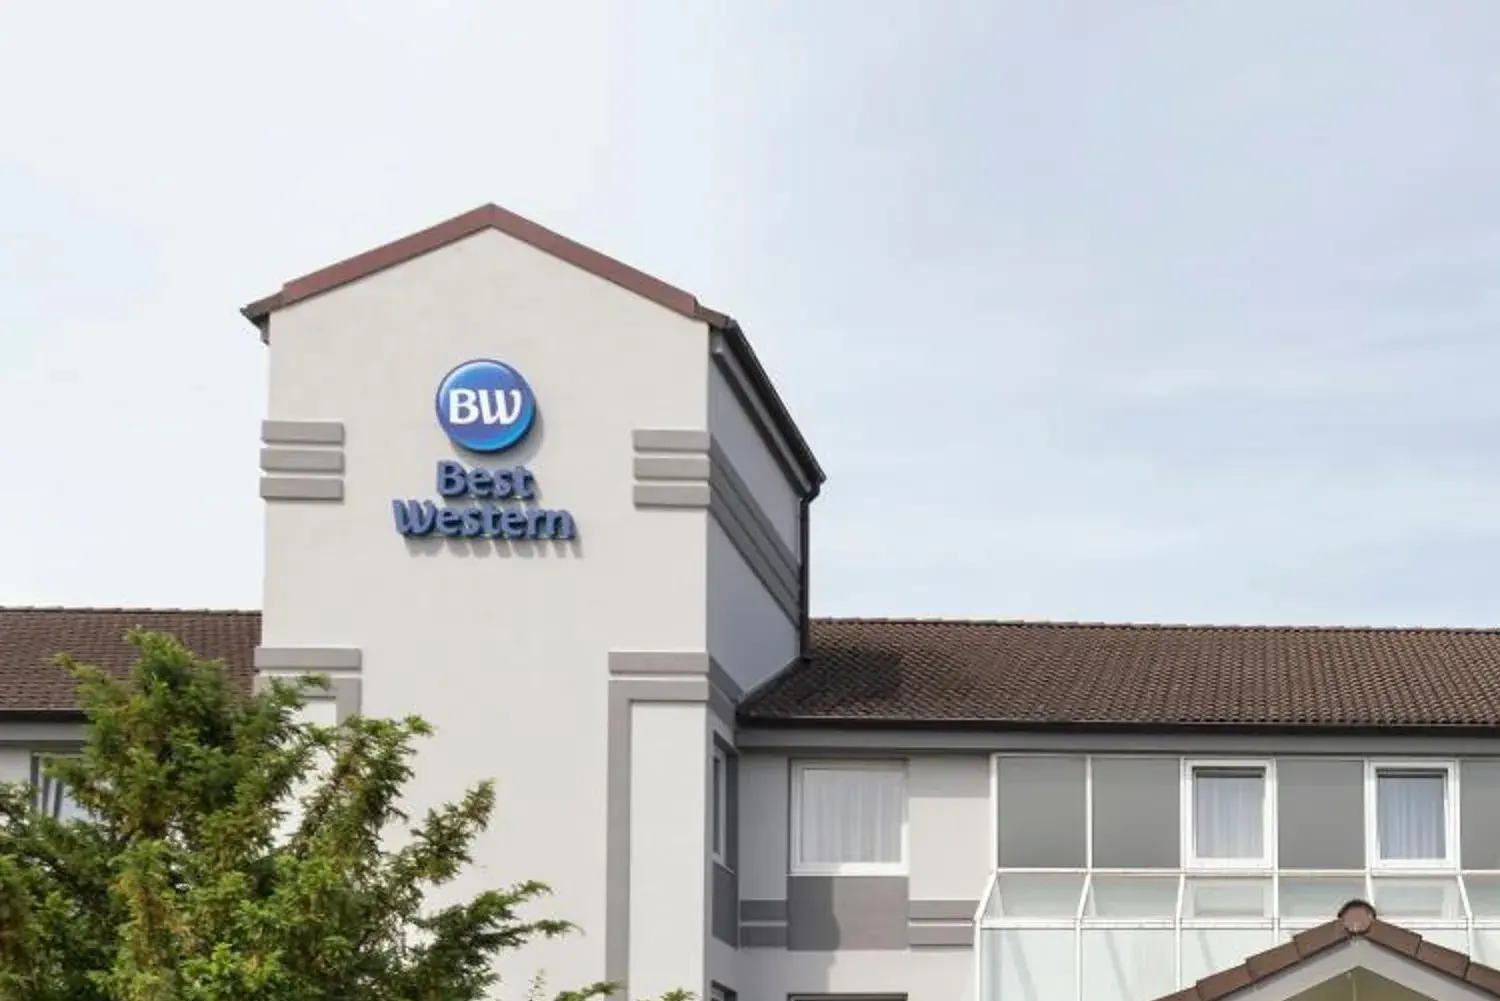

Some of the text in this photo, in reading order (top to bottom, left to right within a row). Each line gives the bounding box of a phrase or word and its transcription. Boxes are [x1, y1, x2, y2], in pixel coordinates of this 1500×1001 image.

[449, 388, 523, 425] BW
[436, 460, 535, 500] Best
[392, 499, 577, 541] Western
